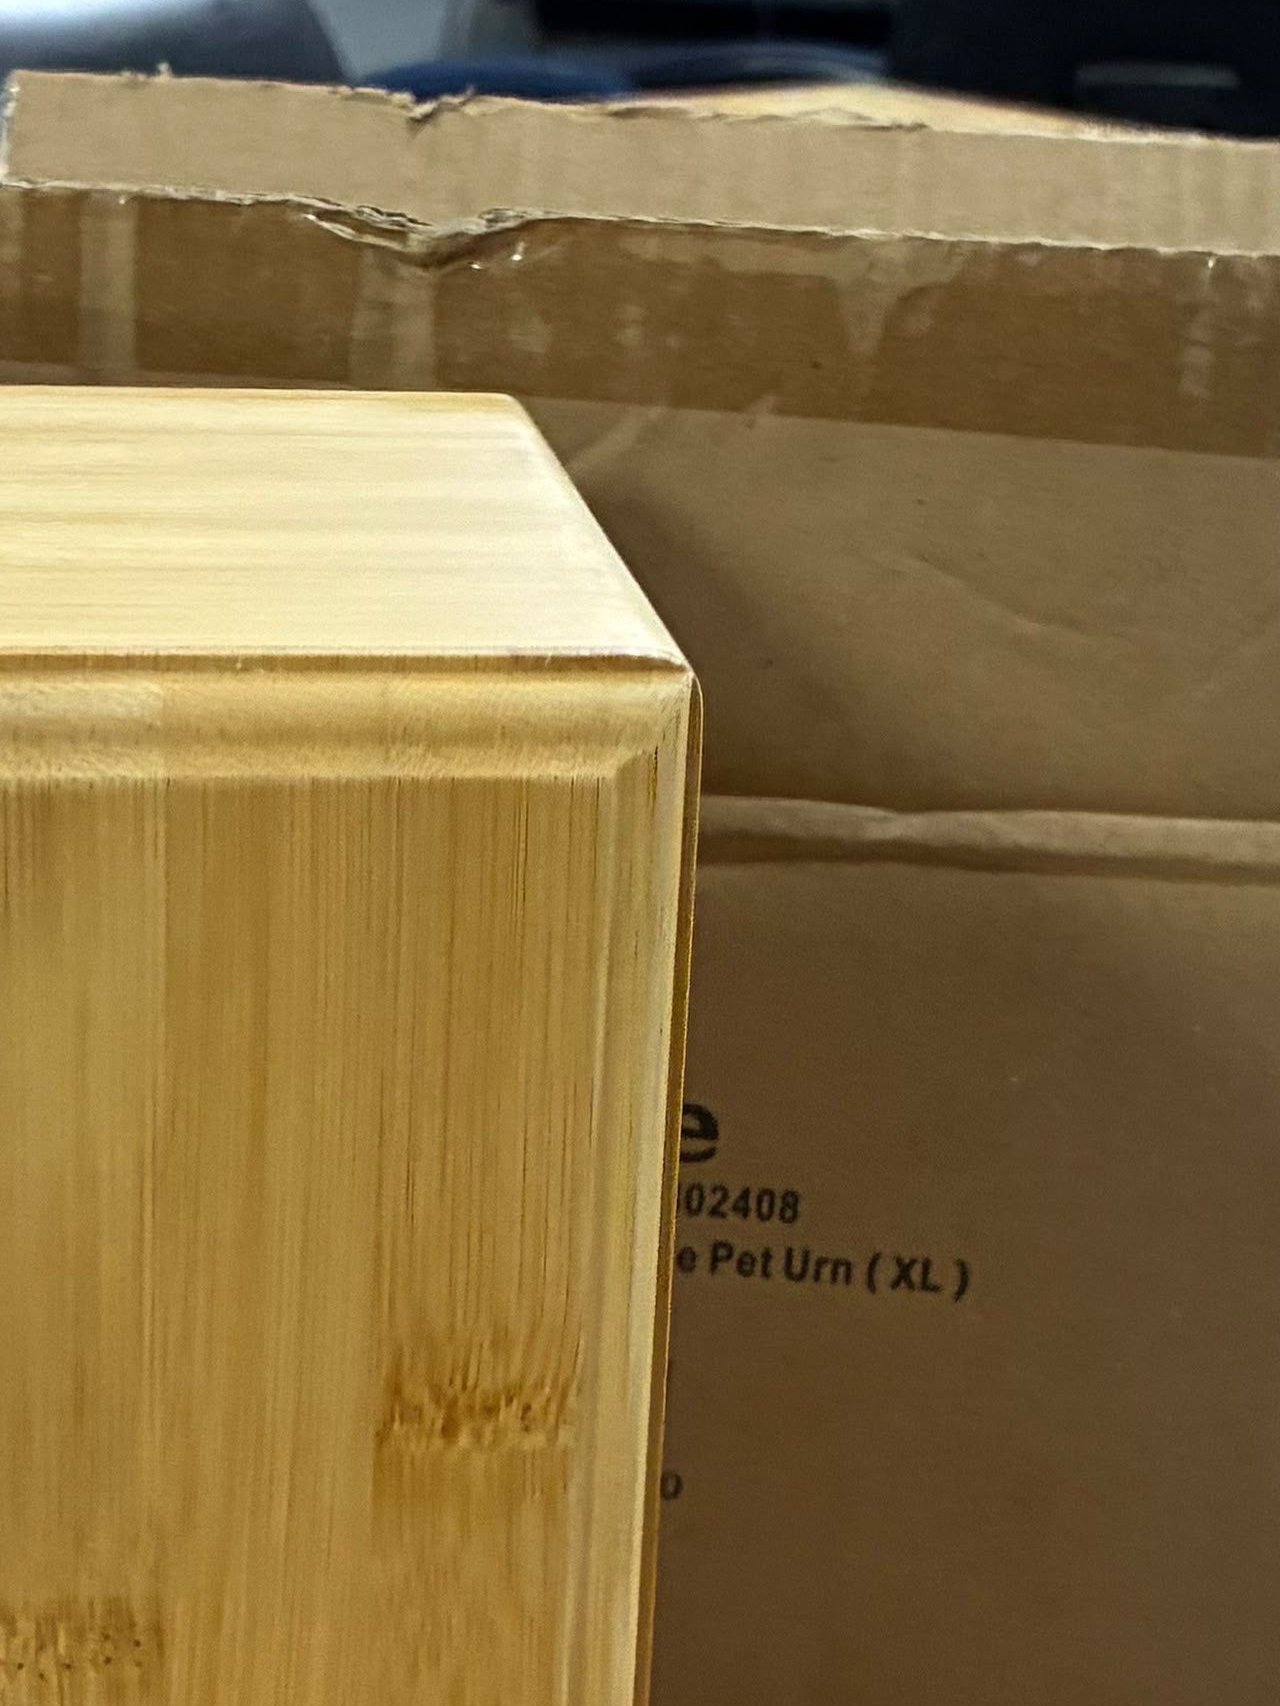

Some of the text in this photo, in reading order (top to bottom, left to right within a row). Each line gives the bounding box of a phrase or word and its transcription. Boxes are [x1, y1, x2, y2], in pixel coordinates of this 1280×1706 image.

[676, 1182, 800, 1224] 02408
[710, 1239, 773, 1279] Pet
[783, 1246, 854, 1285] Urn
